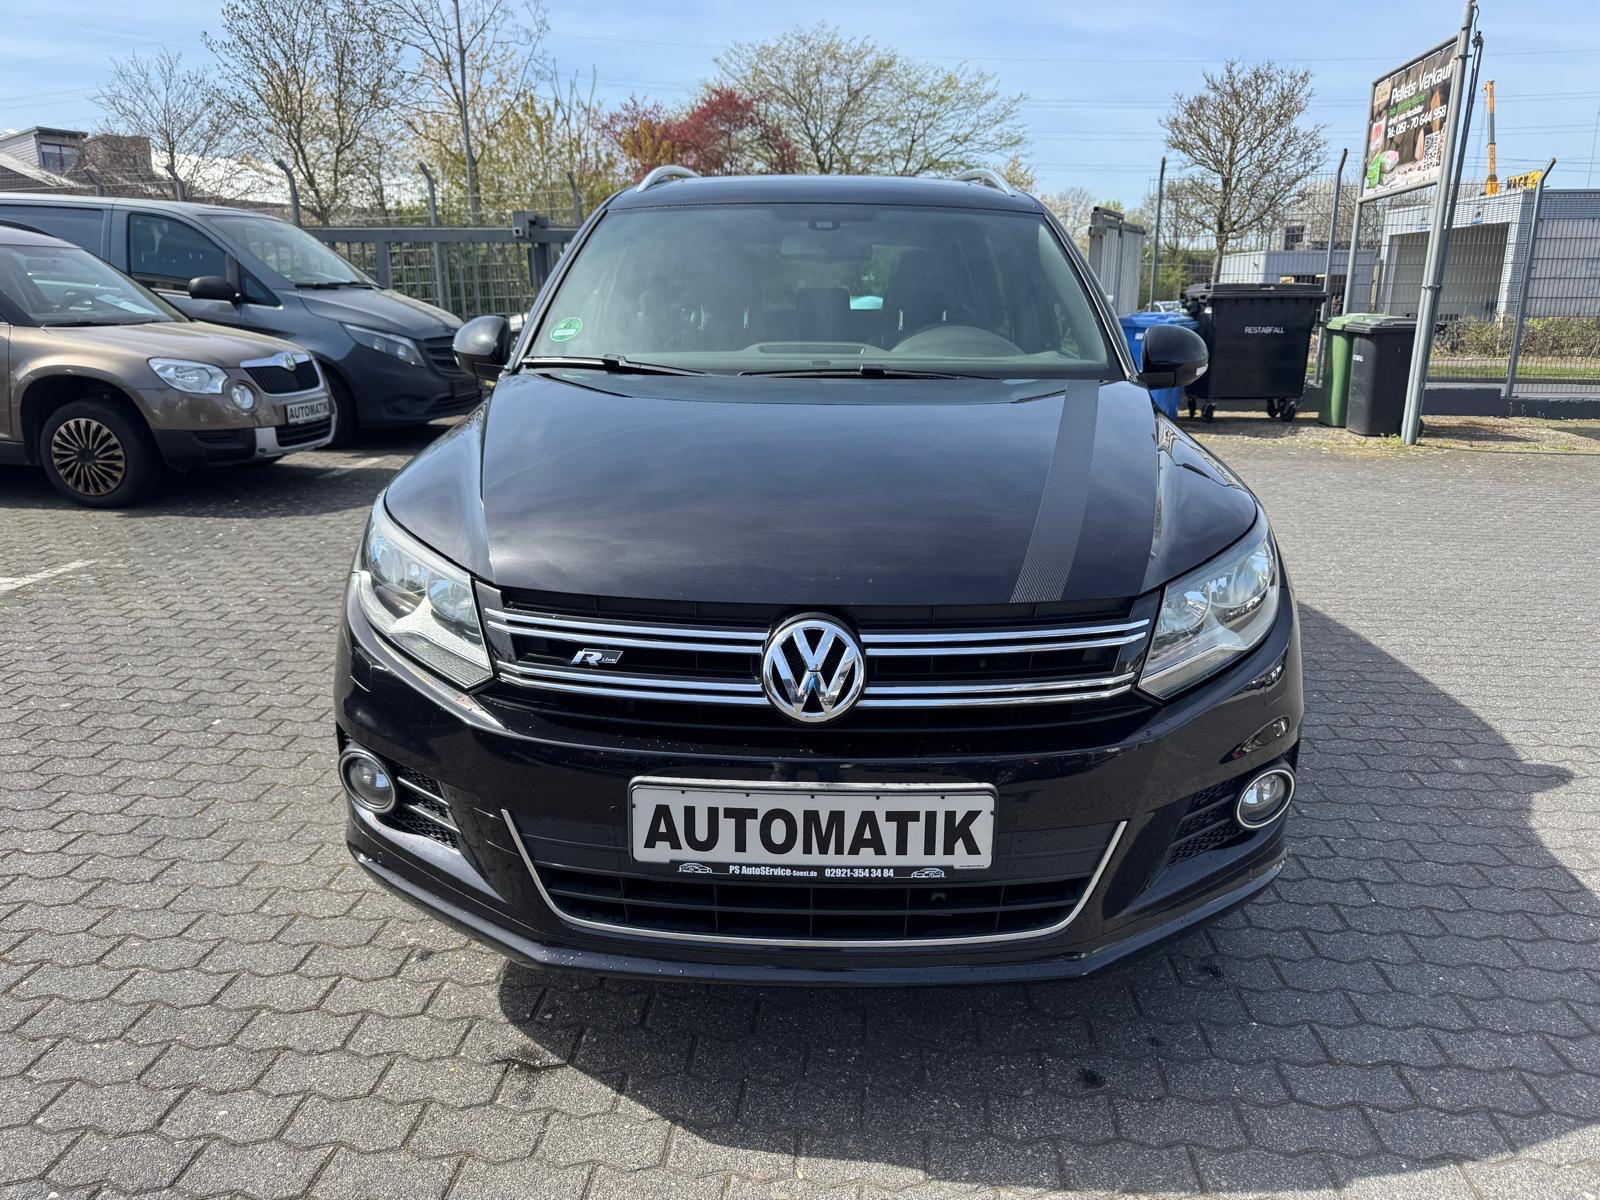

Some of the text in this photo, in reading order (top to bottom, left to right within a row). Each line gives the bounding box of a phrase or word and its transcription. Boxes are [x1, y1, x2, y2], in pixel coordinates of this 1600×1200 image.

[1391, 80, 1417, 105] Pellets
[1419, 62, 1453, 91] Verkauf
[1410, 116, 1419, 129] 70
[1244, 326, 1285, 334] RESTABFALL
[571, 650, 603, 666] R
[767, 623, 861, 718] VW
[643, 803, 984, 856] AUTOMATIK
[729, 865, 740, 874] PS
[824, 868, 869, 877] 02921-354
[870, 868, 881, 877] 34
[882, 869, 894, 878] 84
